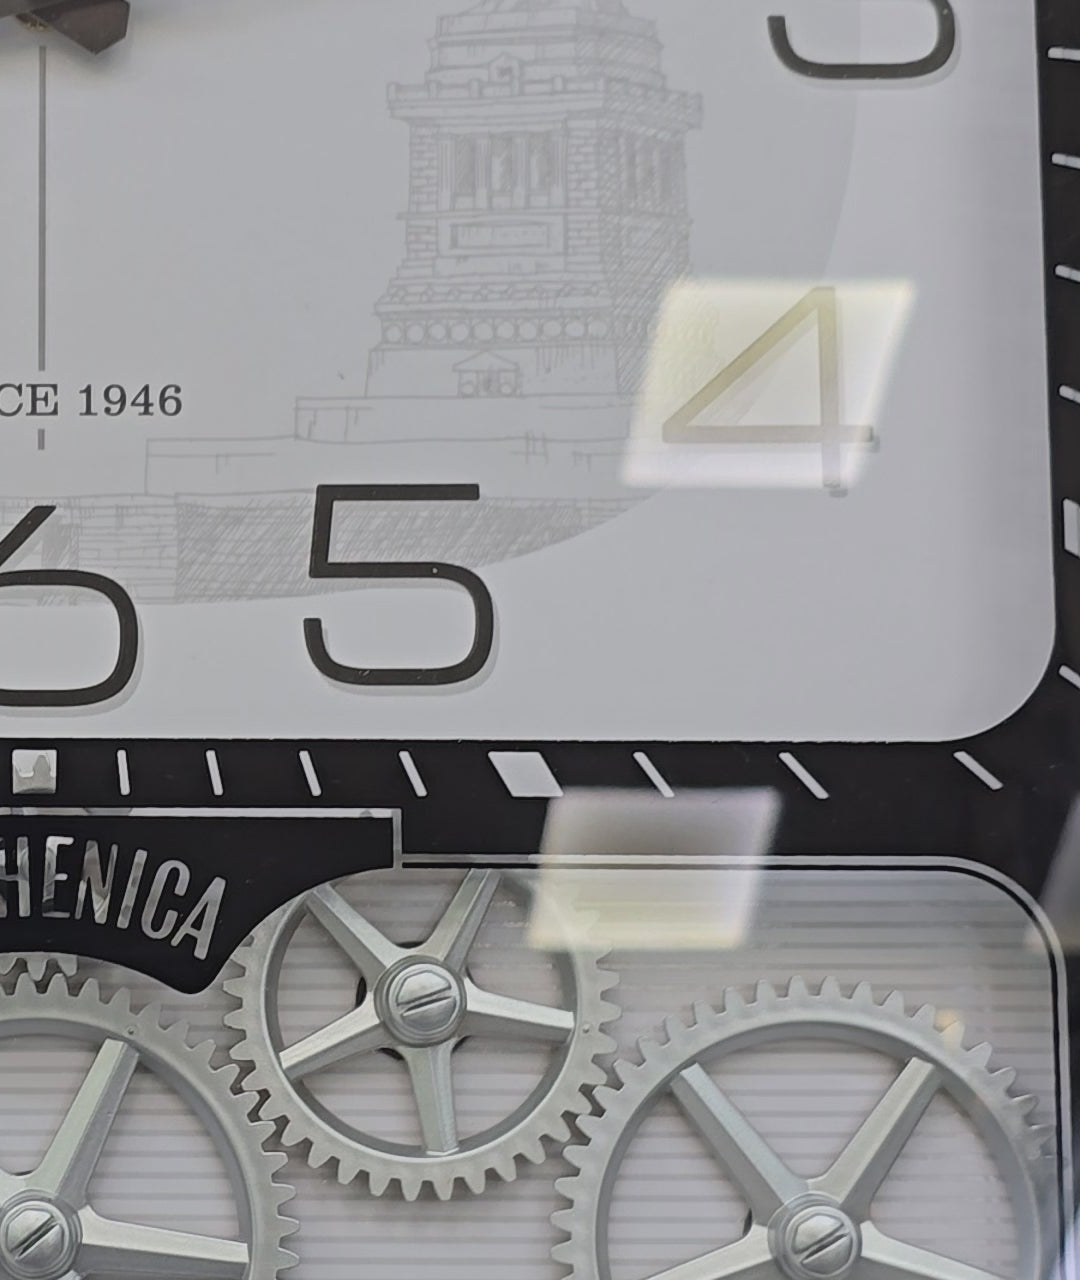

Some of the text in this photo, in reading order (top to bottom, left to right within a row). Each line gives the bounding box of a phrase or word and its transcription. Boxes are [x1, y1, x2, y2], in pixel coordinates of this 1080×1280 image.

[77, 383, 184, 418] 1946
[661, 286, 874, 490] 4
[303, 483, 495, 686] 5
